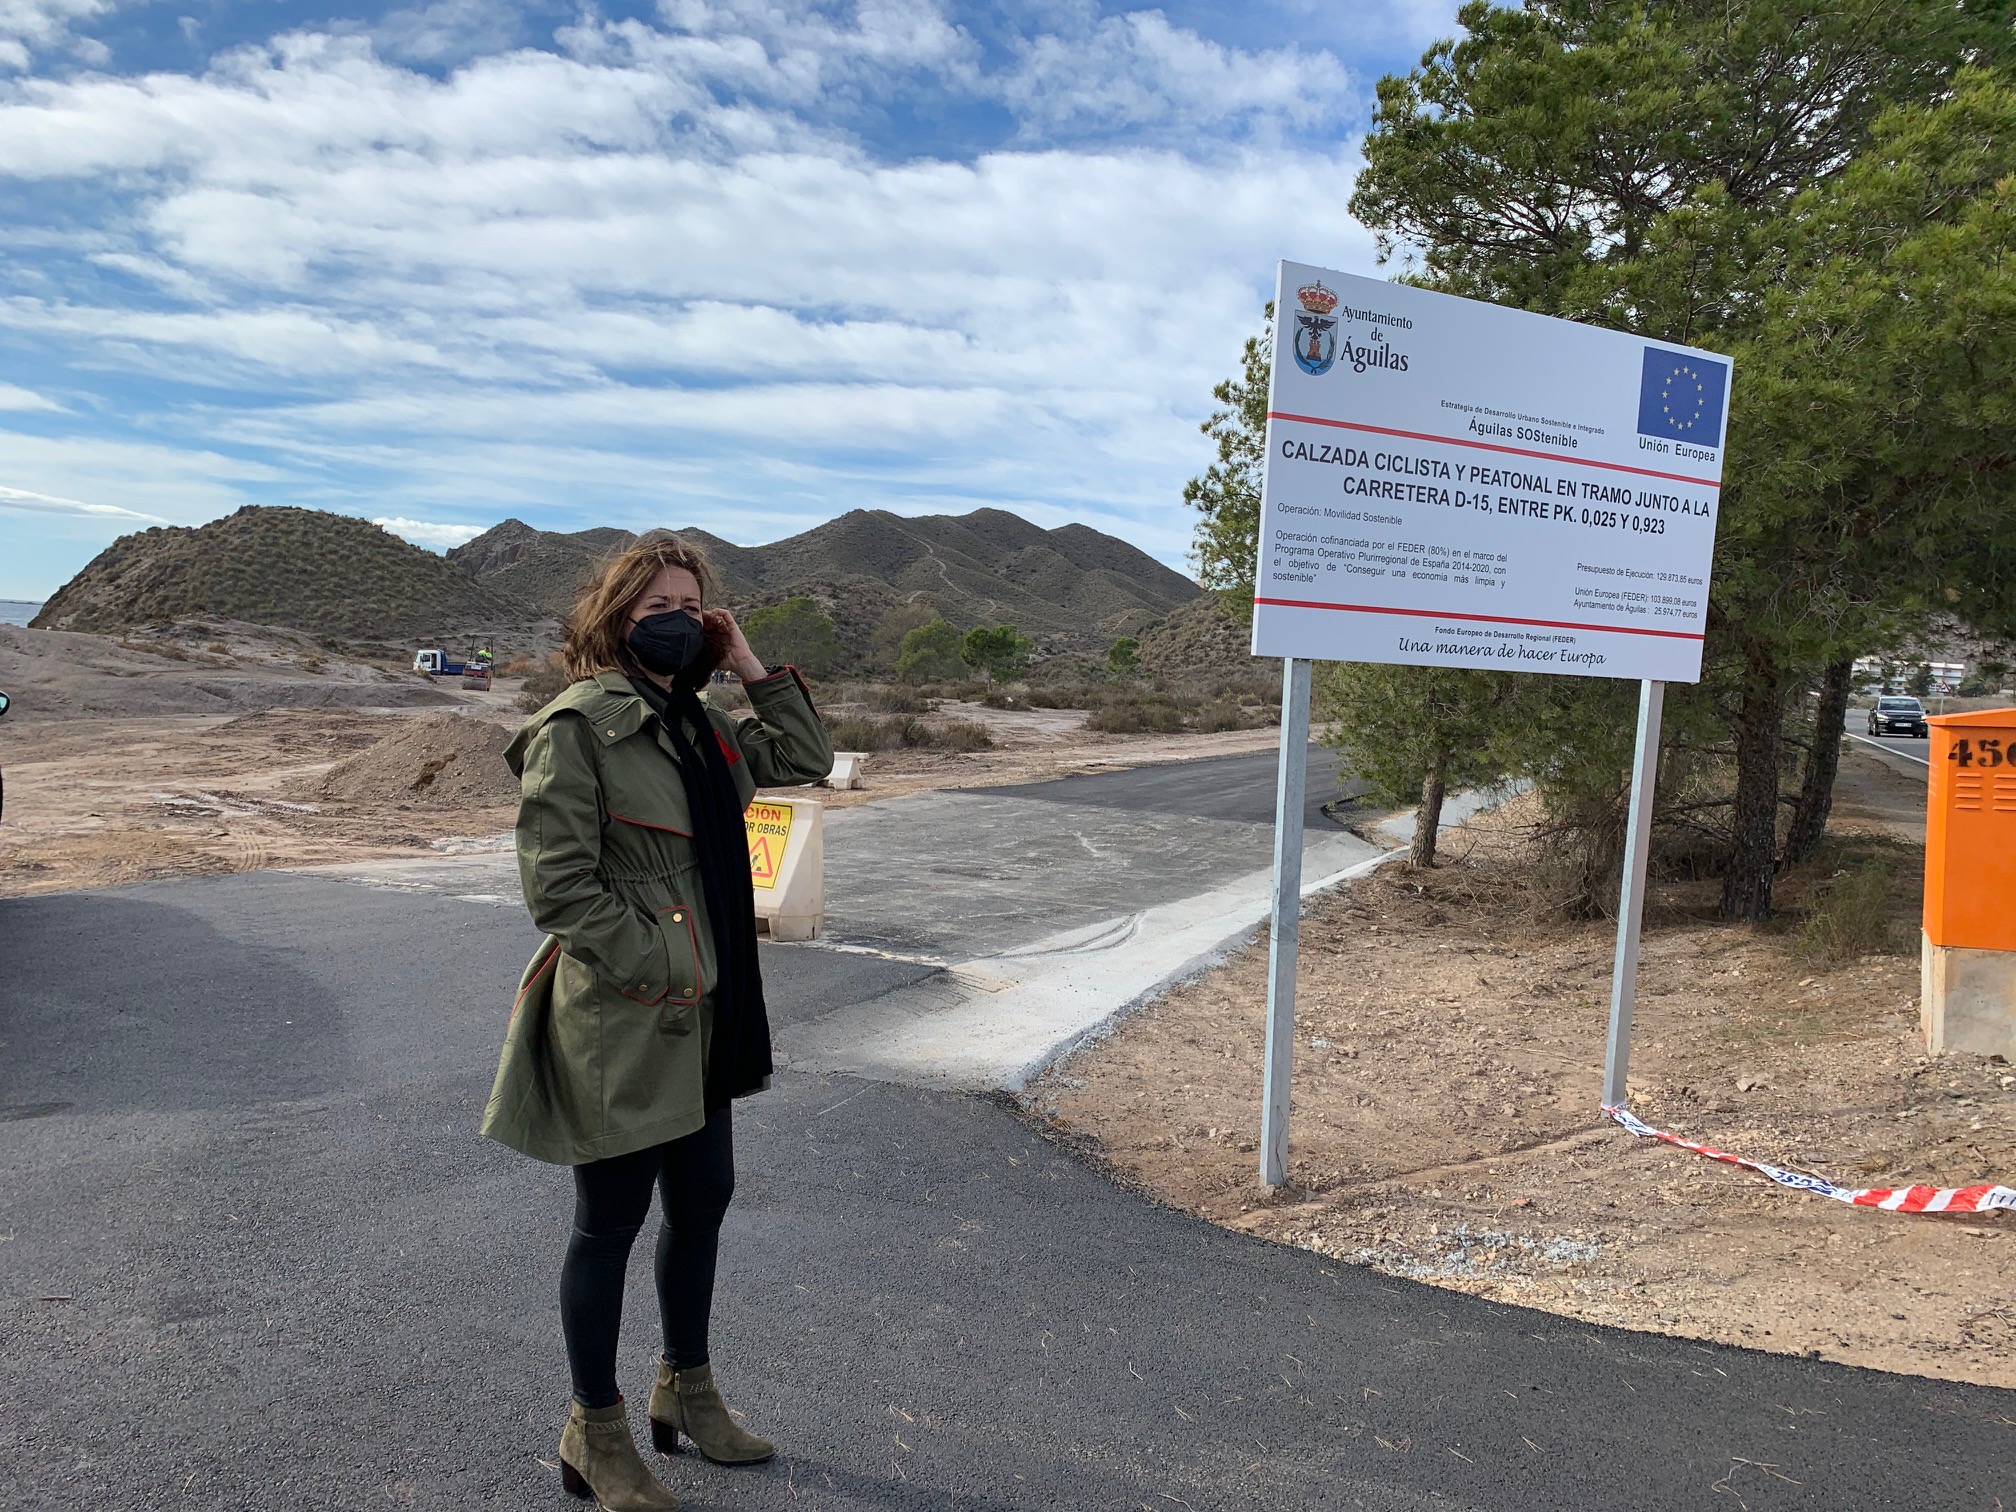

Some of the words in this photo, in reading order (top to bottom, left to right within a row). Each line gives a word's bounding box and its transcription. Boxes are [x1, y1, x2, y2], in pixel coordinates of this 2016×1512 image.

[1342, 306, 1412, 329] Ayuntamiento
[1371, 327, 1383, 342] de
[1340, 336, 1409, 373] Águilas
[1441, 400, 1473, 412] Estrategia
[1484, 408, 1516, 419] Desarrollo
[1518, 414, 1539, 424] Urbano
[1541, 417, 1571, 429] Sostenible
[1578, 423, 1605, 435] Integrado
[1469, 416, 1512, 438] Águilas
[1517, 427, 1578, 449] SOStenible
[1639, 437, 1669, 454] Unión
[1675, 443, 1715, 462] Europea
[1282, 440, 1369, 468] CALZADA
[1375, 452, 1450, 479] CICLISTA
[1455, 464, 1466, 481] Y
[1470, 465, 1552, 494] PEATONAL
[1558, 479, 1576, 497] EN
[1582, 482, 1631, 505] TRAMO
[1635, 492, 1678, 512] JUNTO
[1682, 499, 1690, 514] A
[1694, 502, 1709, 517] LA
[1278, 503, 1321, 516] Operación:
[1324, 508, 1360, 520] Movilidad
[1363, 512, 1402, 525] Sostenible
[1344, 476, 1449, 506] CARRETERA
[1455, 490, 1492, 514] D-15,
[1498, 497, 1549, 518] ENTRE
[1554, 504, 1576, 522] PK.
[1582, 509, 1616, 527] 0,025
[1620, 514, 1629, 529] Y
[1633, 516, 1664, 534] 0,923
[1276, 530, 1317, 542] Operación
[1321, 535, 1369, 547] cofinanciada
[1372, 542, 1385, 550] por
[1388, 542, 1394, 550] el
[1398, 542, 1425, 553] FEDER
[1428, 546, 1449, 558] (80%)
[1464, 550, 1470, 558] el
[1473, 552, 1494, 561] marco
[1497, 554, 1507, 562] del
[1275, 544, 1314, 556] Programa
[1318, 548, 1355, 559] Operativo
[1358, 551, 1407, 565] Plurirregional
[1410, 558, 1419, 566] de
[1423, 558, 1449, 569] España
[1452, 561, 1491, 574] 2014-2020,
[1577, 563, 1615, 575] Presupuesto
[1617, 568, 1624, 576] de
[1626, 568, 1655, 580] Ejecución:
[1274, 558, 1281, 566] el
[1289, 559, 1319, 570] objetivo
[1327, 562, 1336, 571] de
[1454, 575, 1468, 584] más
[1475, 576, 1495, 587] limpia
[1501, 581, 1505, 589] y
[1574, 599, 1615, 610] Ayuntamiento
[1616, 604, 1624, 612] de
[1575, 587, 1593, 596] Unión
[1595, 589, 1619, 600] Europea
[1435, 627, 1455, 635] Fondo
[1457, 628, 1483, 638] Europeo
[1494, 631, 1524, 640] Desarrollo
[1526, 633, 1550, 642] Regional
[1552, 635, 1575, 645] (FEDER)
[1399, 637, 1433, 652] Una
[1436, 642, 1495, 656] manera
[1497, 643, 1515, 658] de
[1518, 645, 1557, 661] hacer
[1560, 649, 1607, 668] Europa
[745, 806, 781, 821] CIÓN
[757, 823, 787, 836] OBRAS
